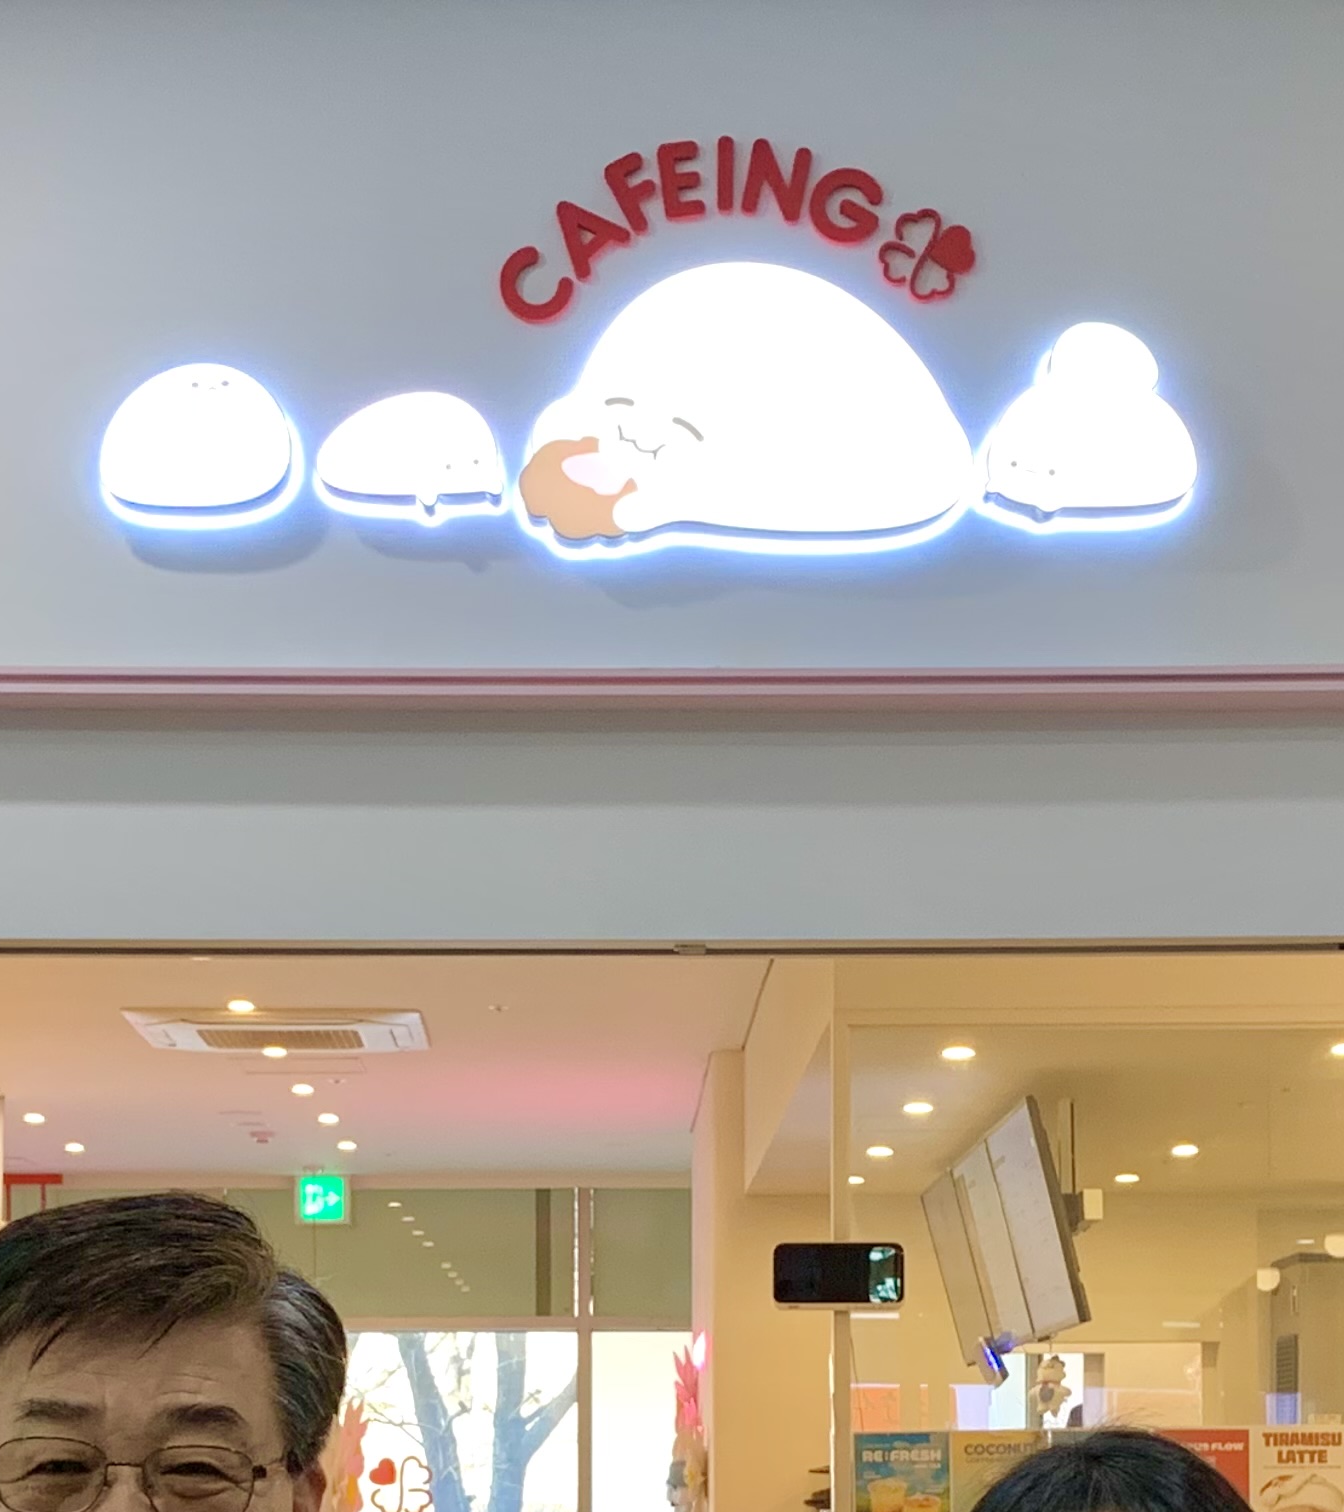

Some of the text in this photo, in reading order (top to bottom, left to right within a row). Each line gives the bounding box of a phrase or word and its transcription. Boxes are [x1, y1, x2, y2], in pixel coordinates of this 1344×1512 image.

[499, 135, 884, 322] CAFEING
[1211, 1441, 1245, 1451] FLOW
[1262, 1432, 1343, 1447] TIRAMISU
[1276, 1449, 1328, 1464] LATTE
